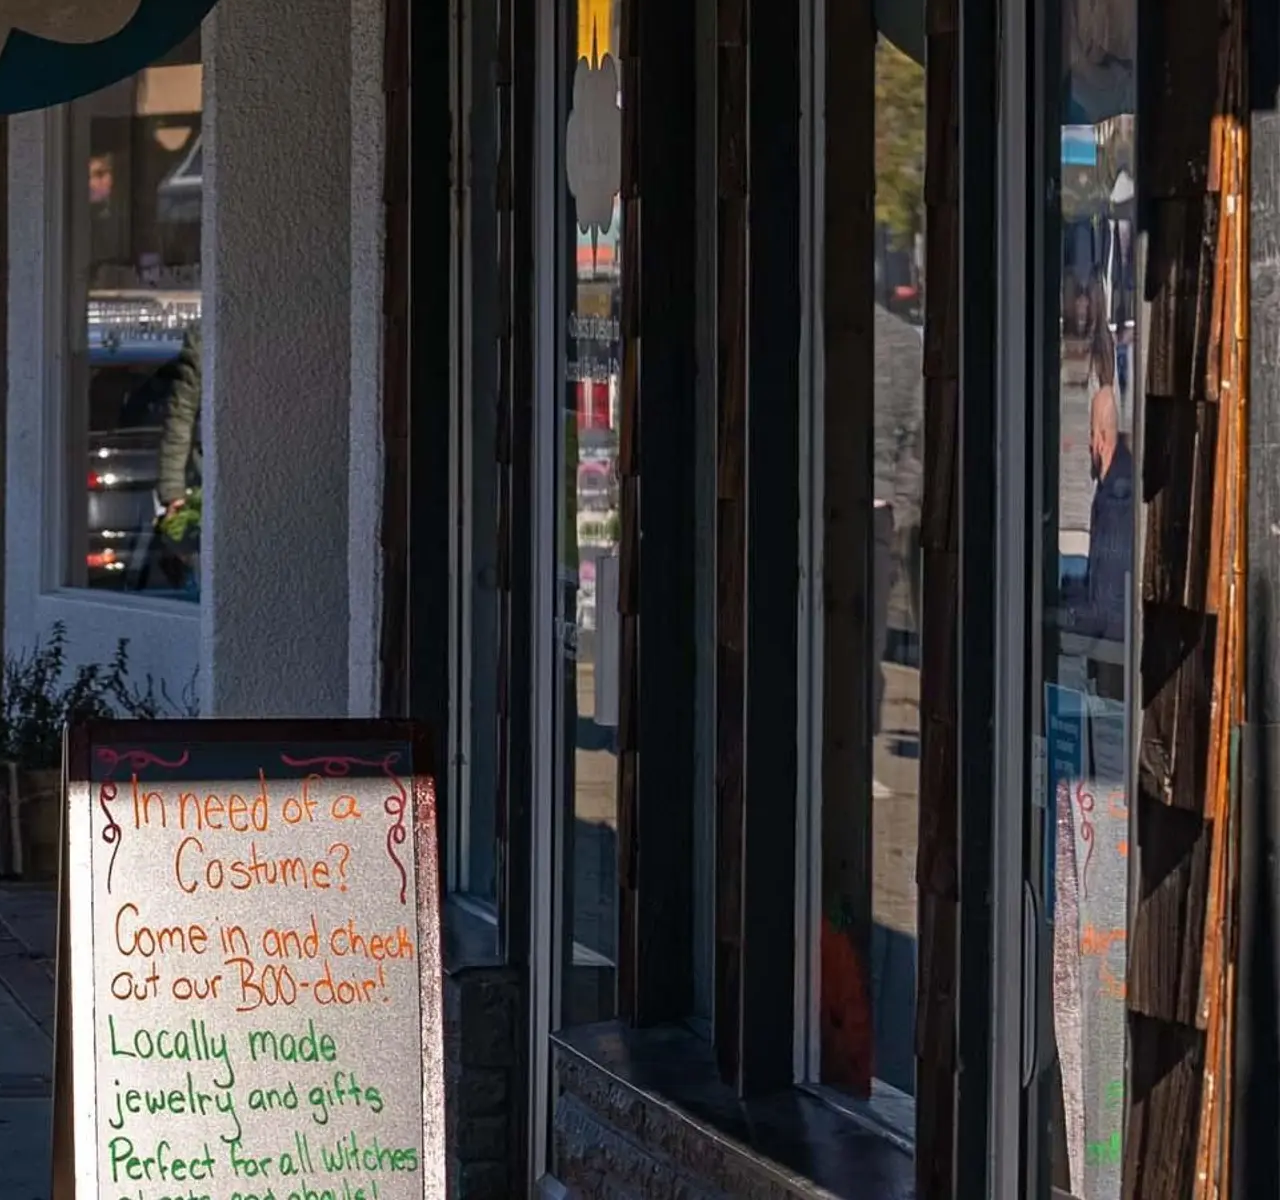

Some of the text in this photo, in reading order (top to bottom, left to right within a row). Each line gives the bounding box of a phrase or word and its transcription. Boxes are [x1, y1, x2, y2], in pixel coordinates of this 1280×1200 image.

[130, 767, 361, 833] In need of a
[174, 836, 351, 893] Costume?
[115, 902, 415, 961] Come in and check
[172, 973, 223, 1001] our
[108, 1015, 336, 1089] Locally made
[109, 1071, 384, 1142] jewelry and gifts
[108, 1129, 417, 1183] Perfect for all witches
